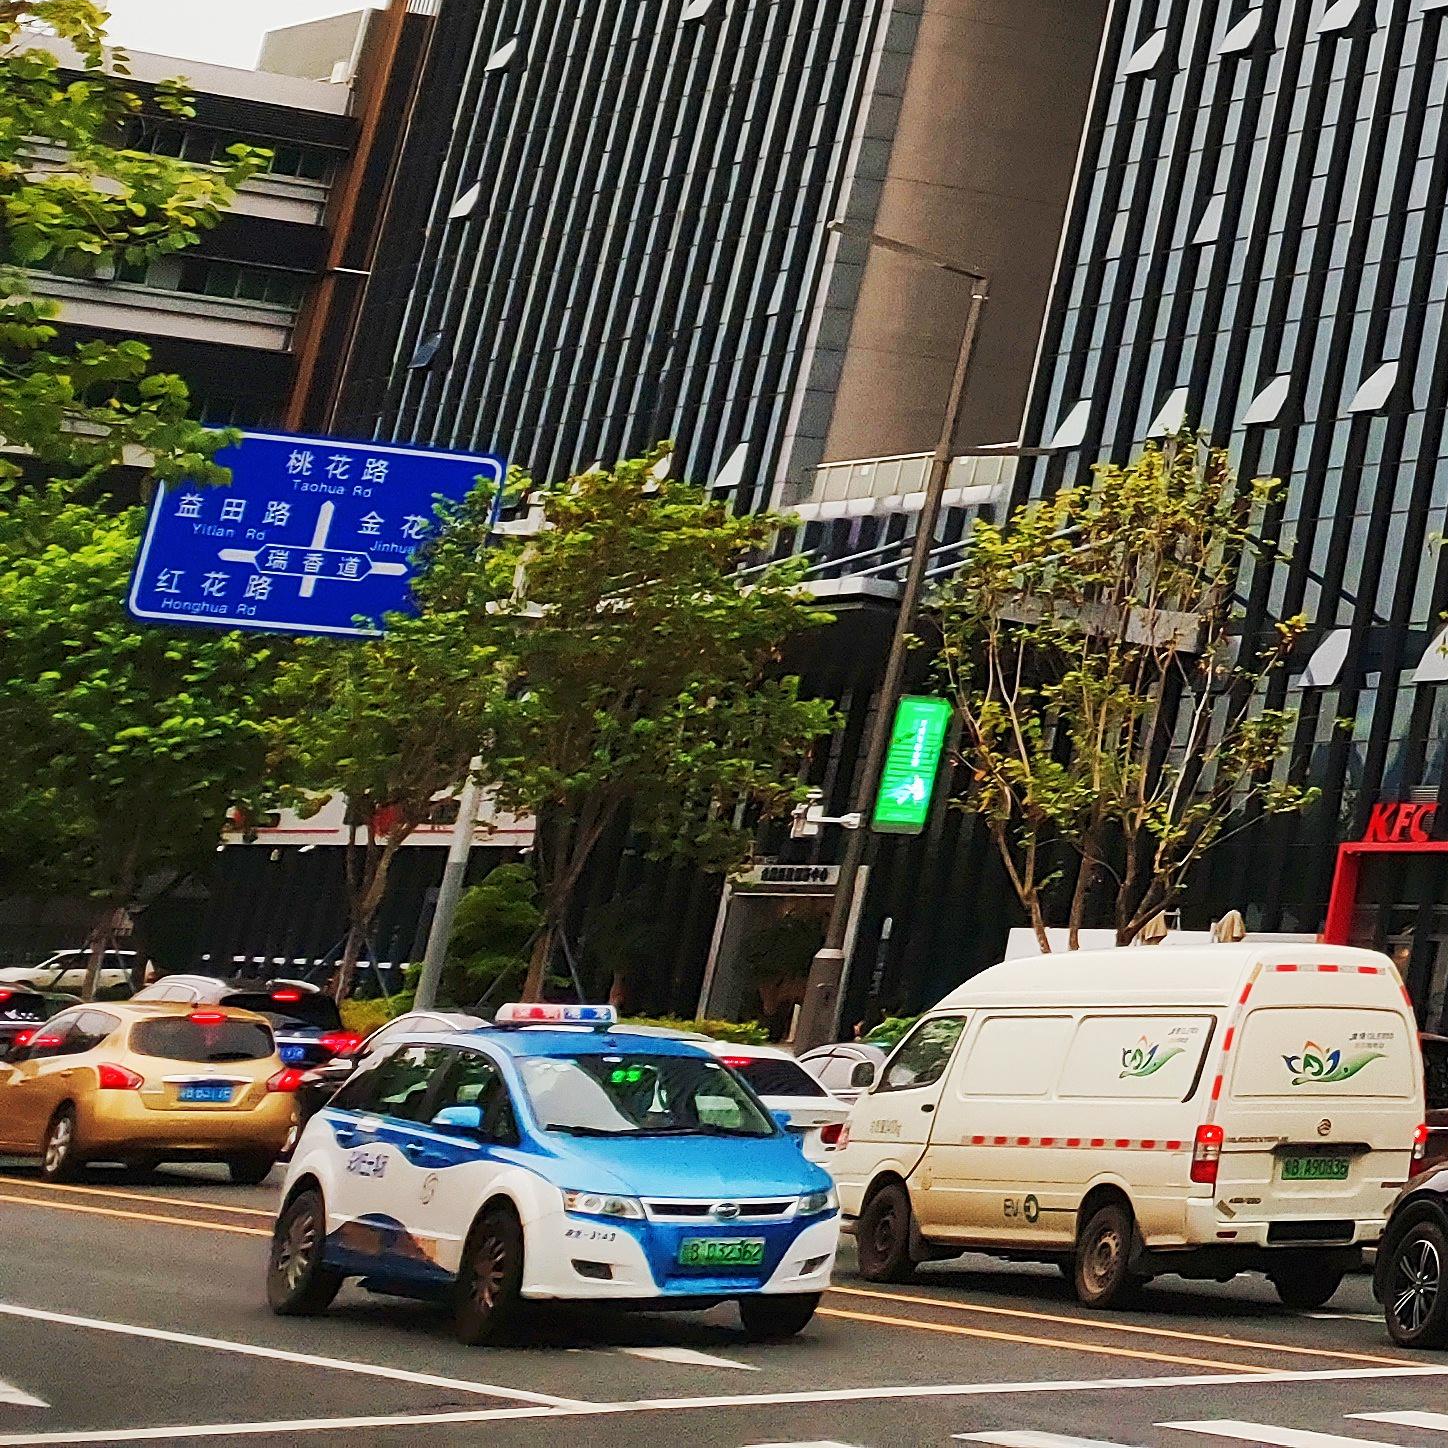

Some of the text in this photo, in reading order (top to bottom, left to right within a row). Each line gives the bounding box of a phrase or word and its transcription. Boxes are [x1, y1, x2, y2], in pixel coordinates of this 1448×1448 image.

[286, 450, 389, 484] 桃花路
[292, 479, 373, 499] Taohua Rd
[174, 492, 291, 527] 益田路
[193, 522, 267, 541] Yitian Rd
[357, 510, 430, 540] 金花
[369, 540, 416, 555] Jinhua
[265, 549, 362, 578] 瑞香道
[154, 567, 273, 601] 红花路
[161, 598, 257, 617] Honghua Rd
[1363, 802, 1438, 842] KFC
